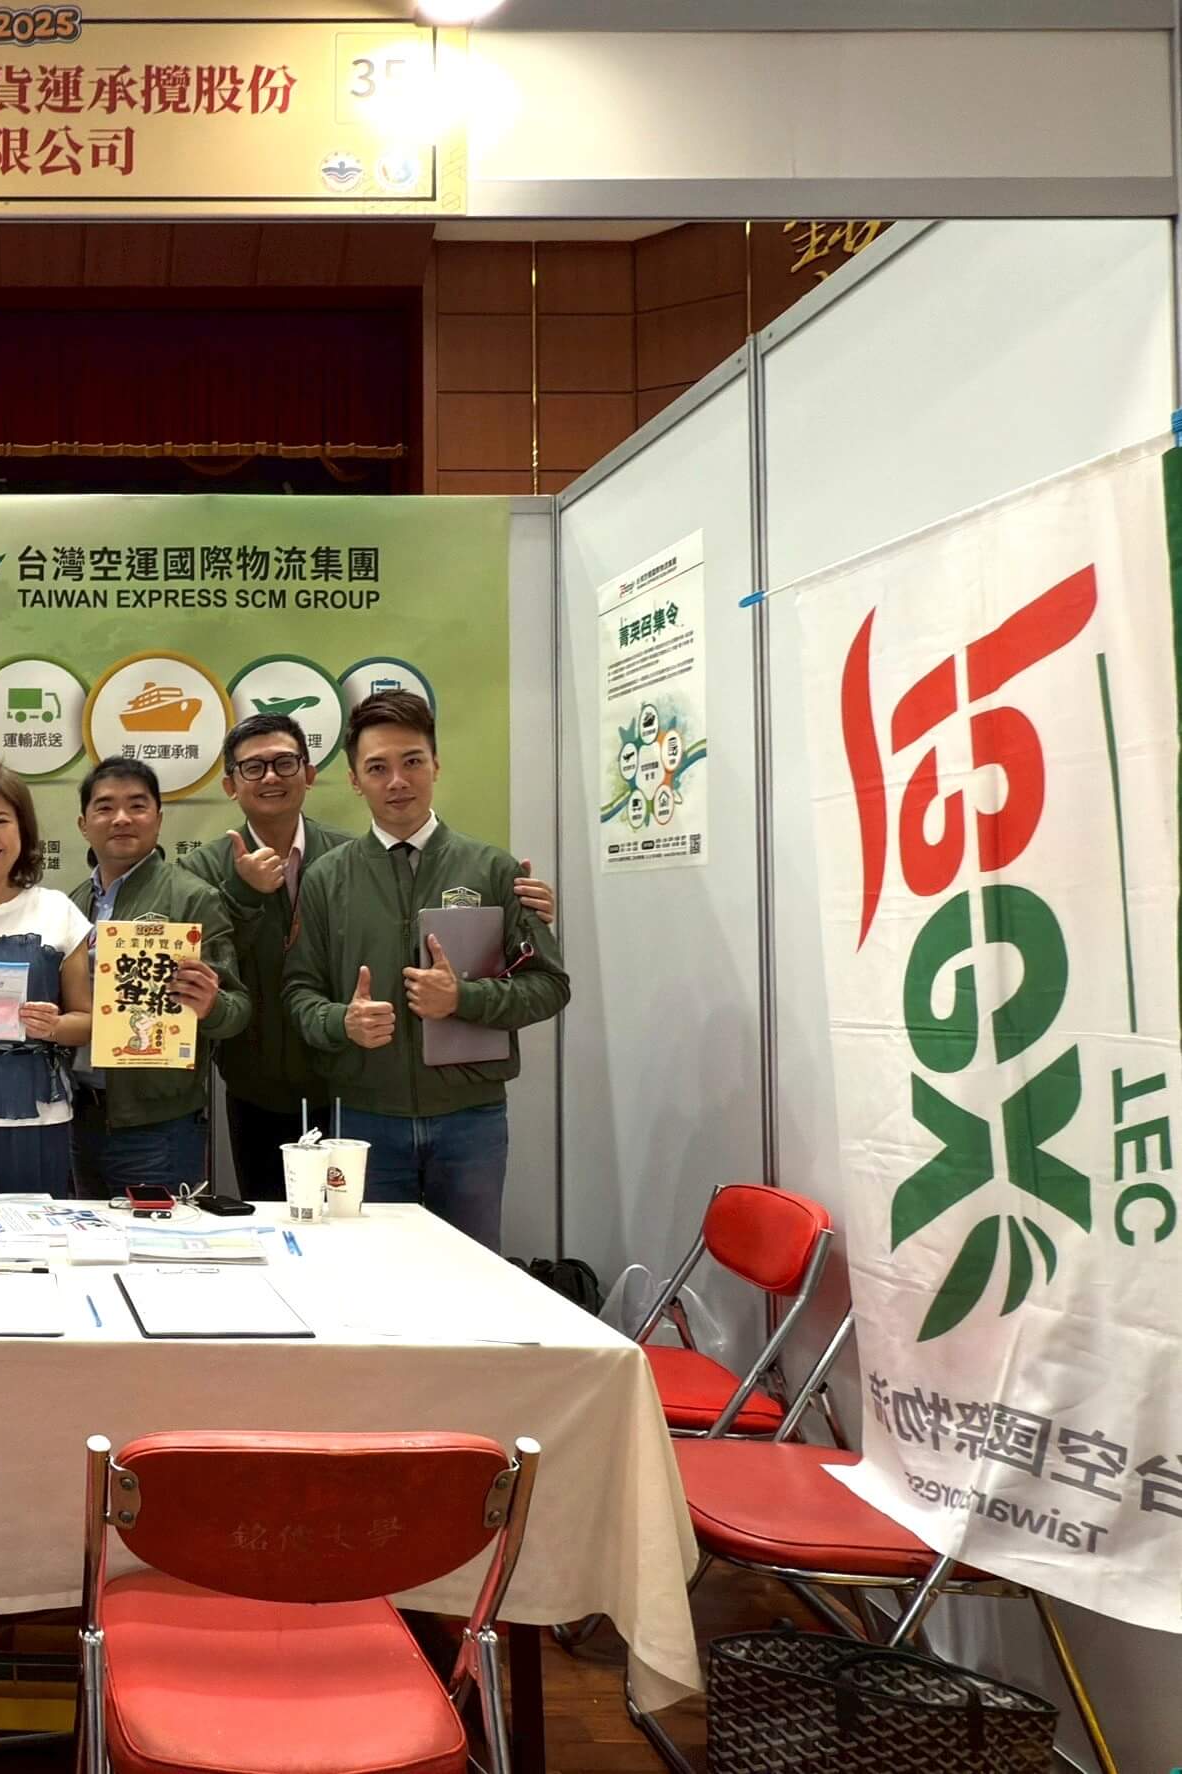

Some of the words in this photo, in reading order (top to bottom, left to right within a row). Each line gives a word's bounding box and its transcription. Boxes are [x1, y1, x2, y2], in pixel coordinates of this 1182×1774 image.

[17, 545, 380, 582] 台灣空運國際物流集團
[18, 589, 108, 609] TAIWAN
[117, 589, 228, 609] EXPRESS
[235, 589, 287, 609] SCM
[295, 589, 380, 609] GROUP
[618, 601, 679, 649] 菁英召集令
[3, 733, 64, 749] 運輸派送
